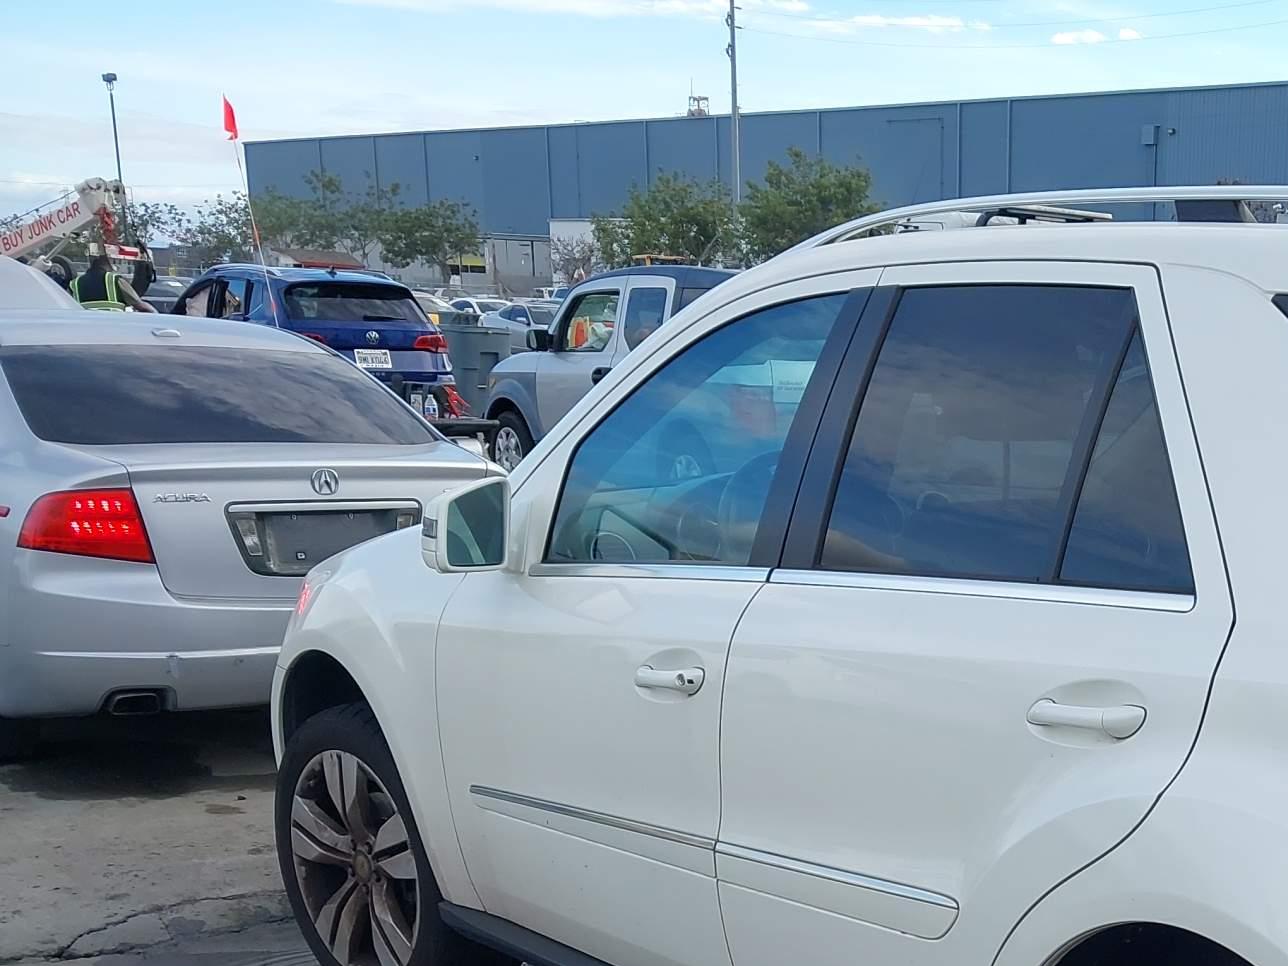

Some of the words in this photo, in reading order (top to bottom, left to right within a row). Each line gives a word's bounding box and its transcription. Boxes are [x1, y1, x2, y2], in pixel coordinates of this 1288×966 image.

[2, 229, 24, 252] BUY
[28, 213, 57, 240] JUNK
[57, 202, 80, 224] CAR
[153, 492, 212, 504] ACURA
